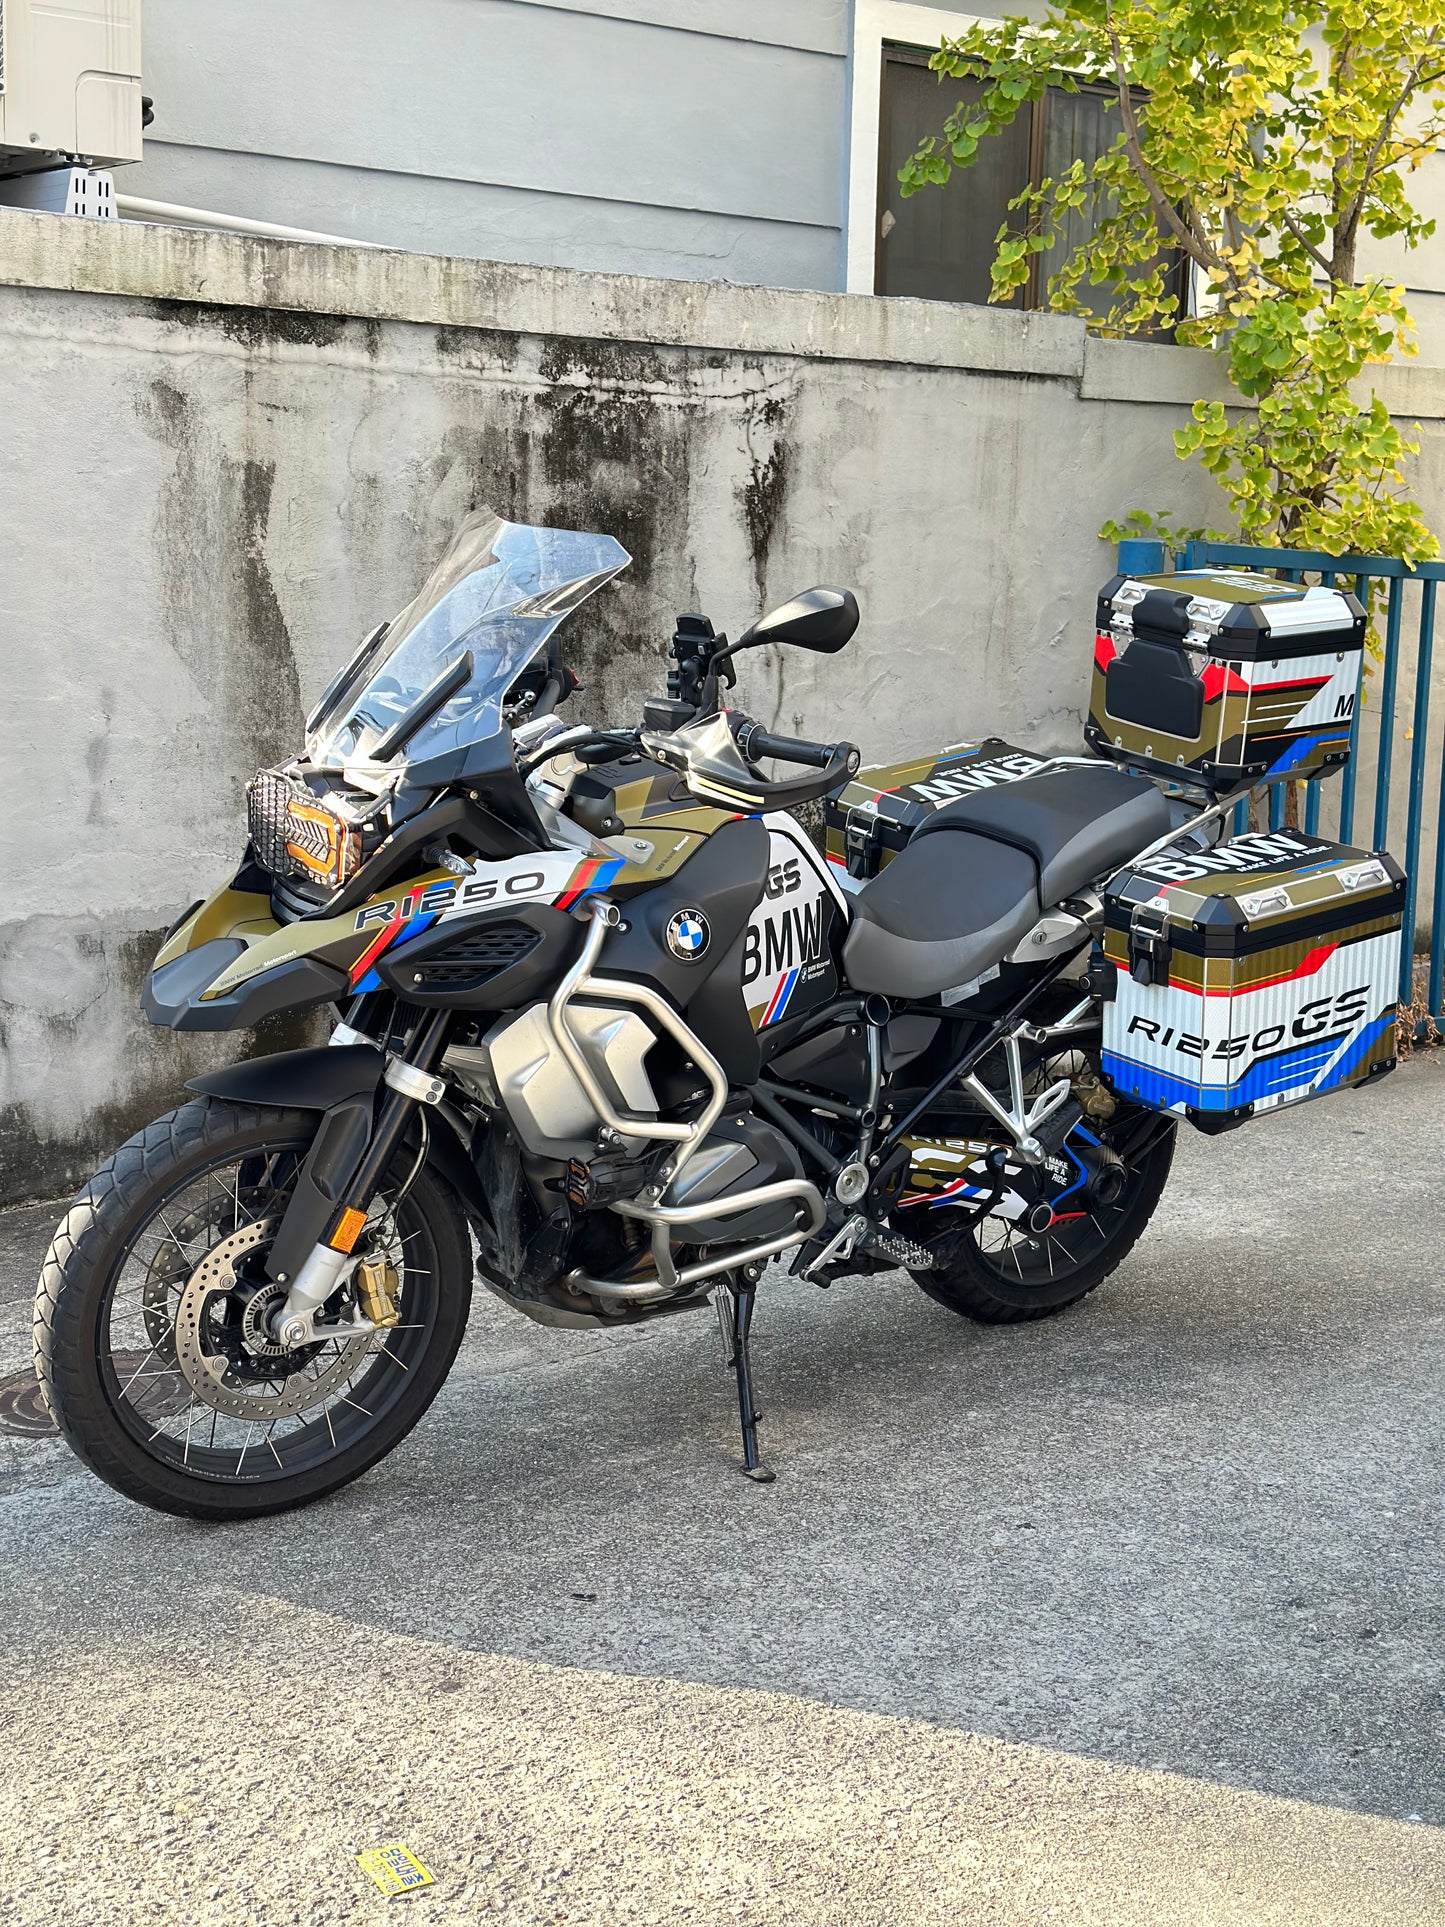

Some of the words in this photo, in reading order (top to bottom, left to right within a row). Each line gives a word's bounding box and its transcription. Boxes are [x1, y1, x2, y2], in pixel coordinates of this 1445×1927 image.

[909, 757, 1044, 800] BMW
[1145, 833, 1308, 881] BMW
[766, 858, 802, 900] GS
[354, 872, 545, 931] R1250
[671, 912, 704, 931] BMW
[742, 897, 822, 986] BMW
[1045, 1162, 1059, 1174] LIFE
[1049, 1156, 1068, 1170] MAKE
